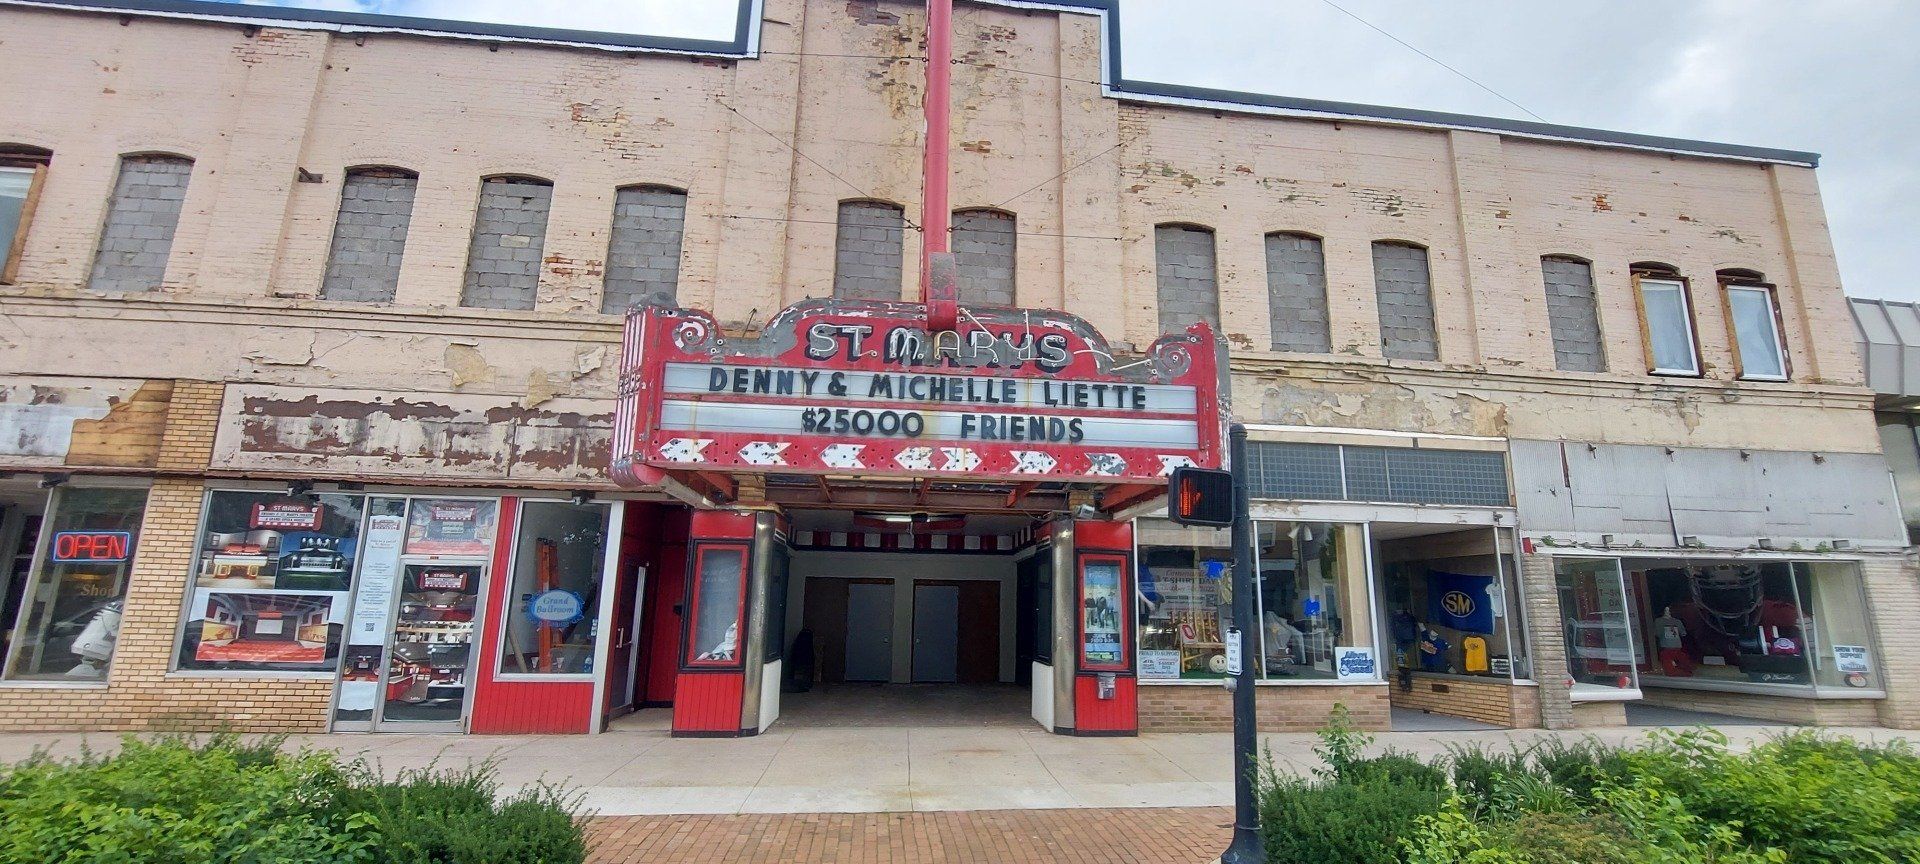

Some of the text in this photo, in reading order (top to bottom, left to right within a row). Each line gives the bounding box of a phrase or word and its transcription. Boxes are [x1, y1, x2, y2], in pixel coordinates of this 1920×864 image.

[884, 326, 1069, 372] MARYS
[709, 367, 1147, 409] DENNY & MICHELLE LIETTE
[801, 407, 1084, 443] $25000 FRIENDS
[57, 534, 127, 559] OPEN
[536, 605, 574, 614] Ballroom
[543, 596, 569, 605] Grand
[1445, 593, 1471, 615] SM
